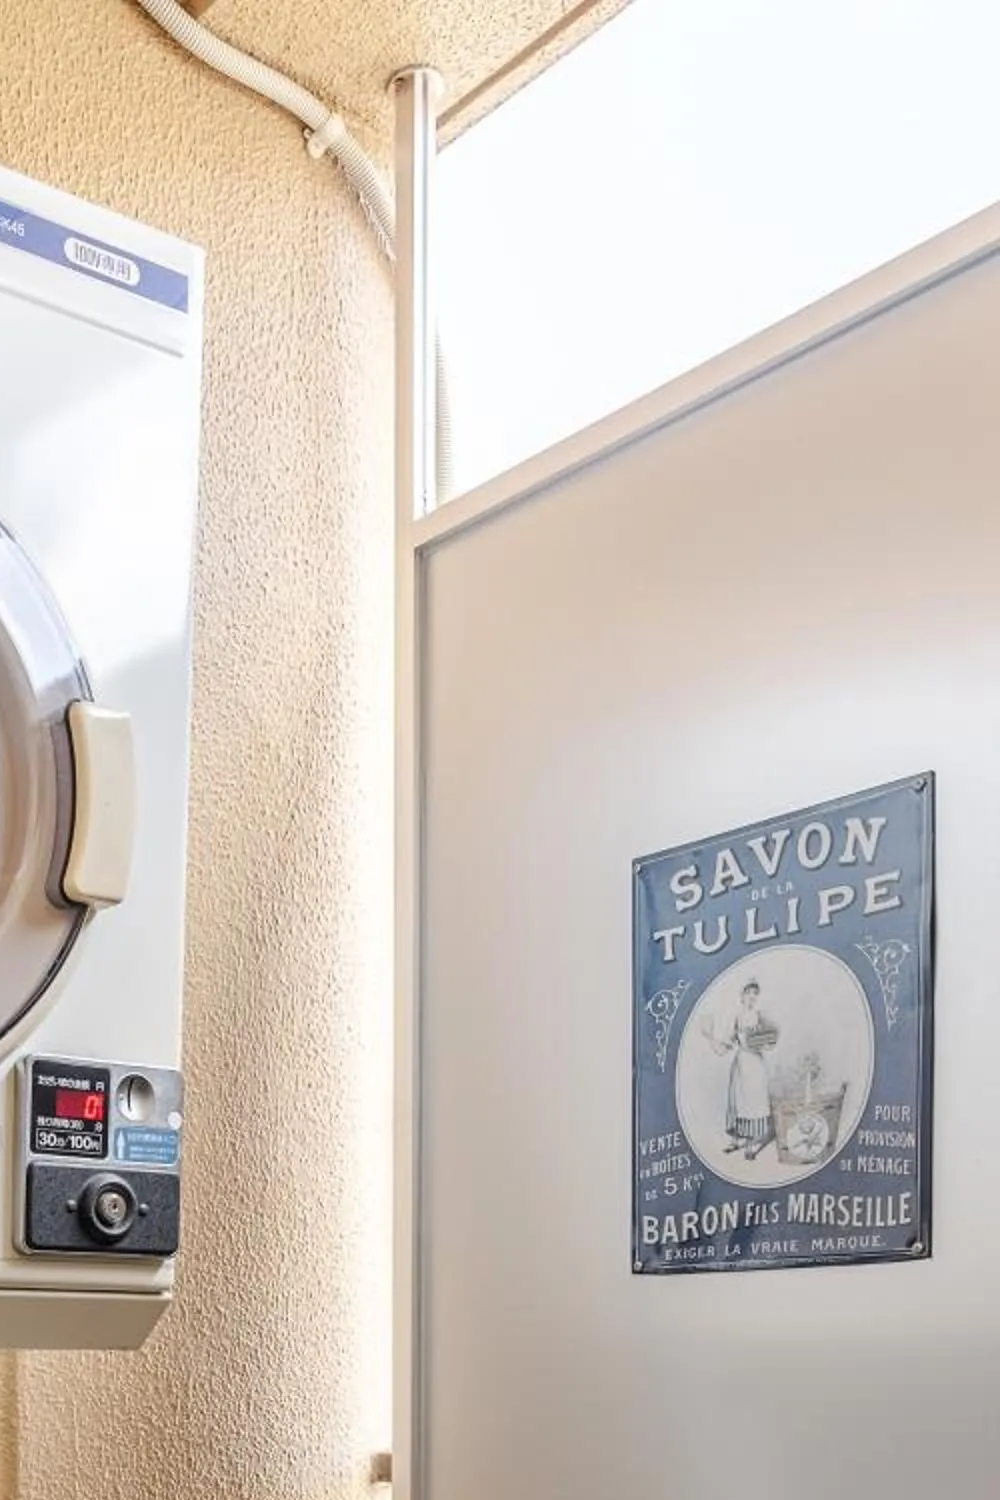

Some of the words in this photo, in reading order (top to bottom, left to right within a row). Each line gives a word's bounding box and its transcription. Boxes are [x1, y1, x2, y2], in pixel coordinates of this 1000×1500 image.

[669, 817, 887, 913] SAVON
[751, 887, 768, 901] DE
[653, 869, 902, 963] TULIPE
[84, 1095, 99, 1119] 0
[875, 1105, 912, 1123] POUR
[639, 1131, 681, 1155] VENTE
[663, 1177, 678, 1195] 5
[642, 1200, 740, 1246] BARON
[744, 1202, 780, 1227] FILS
[787, 1191, 912, 1228] MARSEILLE
[665, 1245, 715, 1261] EXIGER
[725, 1243, 741, 1257] LA
[751, 1240, 800, 1255] VRAIE
